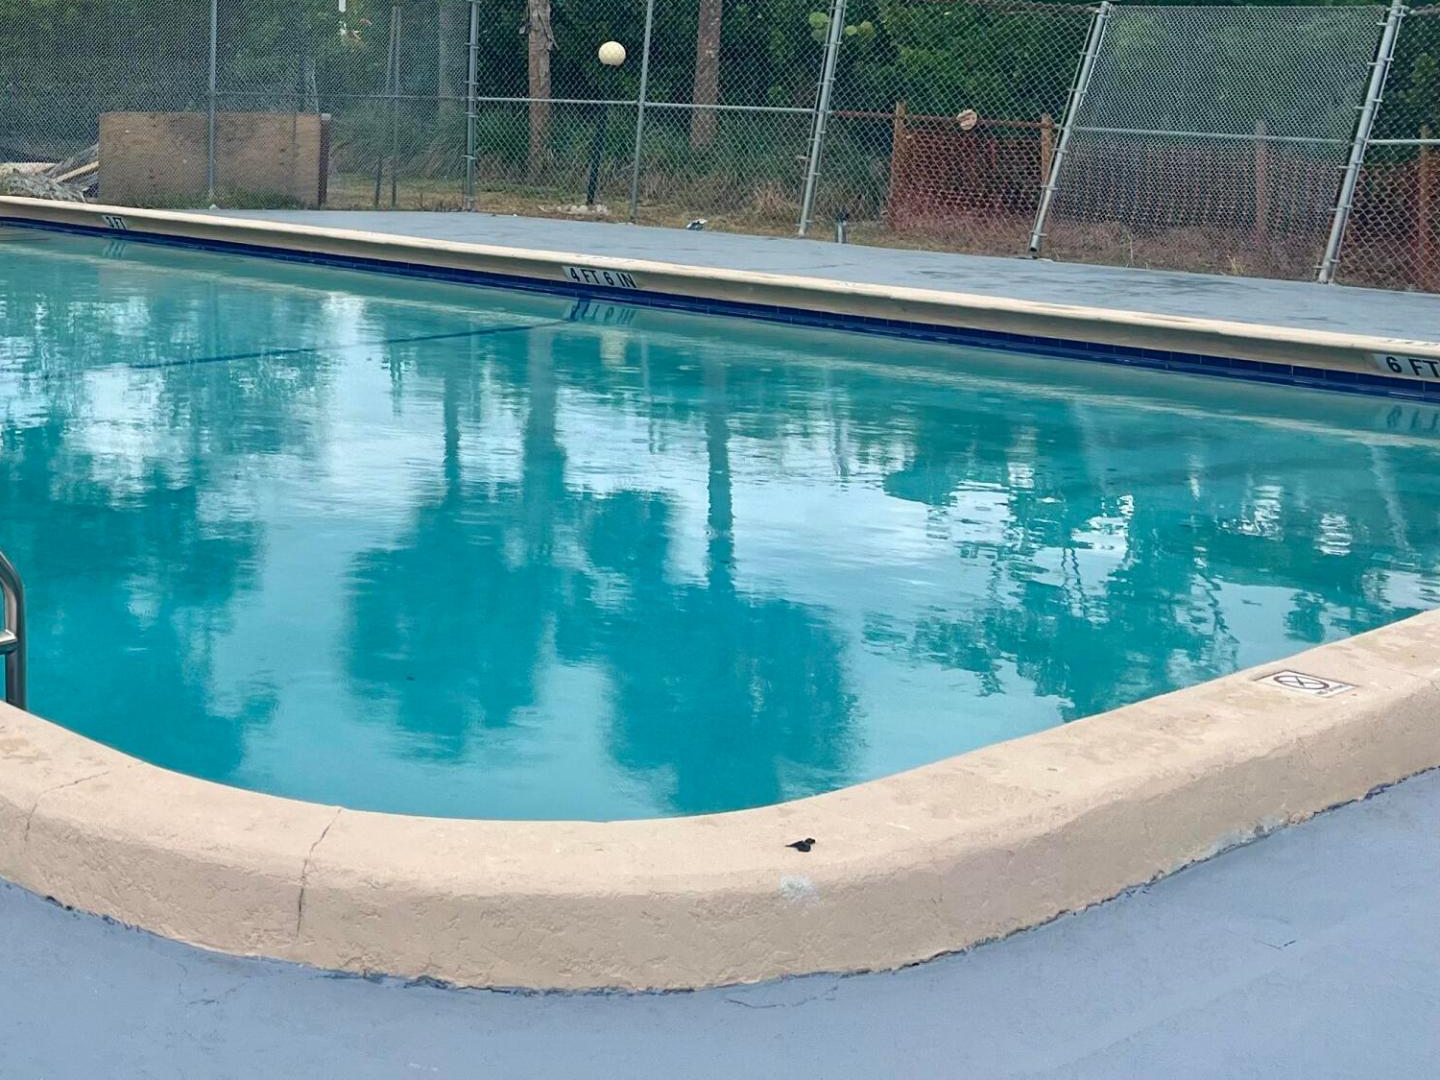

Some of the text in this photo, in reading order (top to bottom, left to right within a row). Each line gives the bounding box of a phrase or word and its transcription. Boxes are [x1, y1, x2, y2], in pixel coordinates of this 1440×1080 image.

[569, 267, 637, 288] 4 FT 6 IN
[1386, 356, 1440, 378] 6 FT
